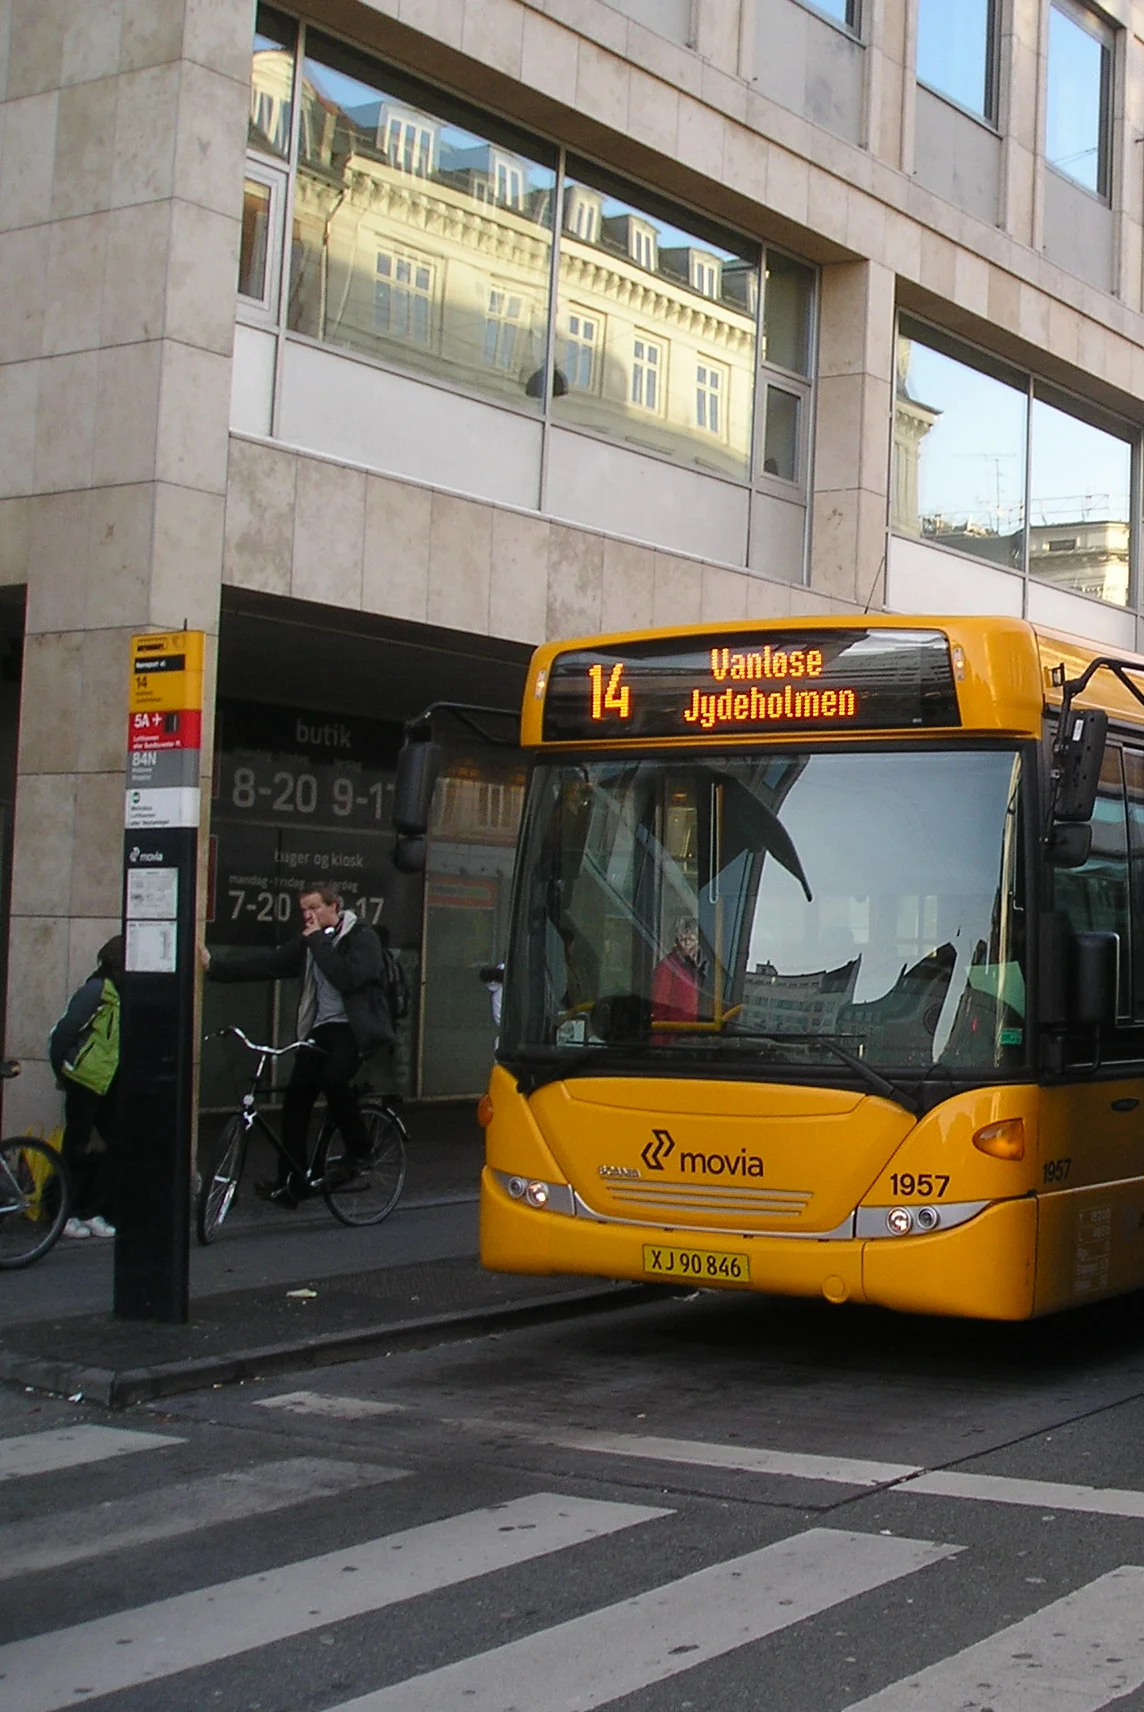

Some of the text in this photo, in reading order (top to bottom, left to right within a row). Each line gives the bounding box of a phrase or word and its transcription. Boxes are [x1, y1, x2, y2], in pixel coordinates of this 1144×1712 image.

[711, 645, 823, 681] Vanløse
[137, 676, 148, 688] 14
[588, 662, 630, 720] 14
[134, 713, 150, 728] 5A
[683, 685, 856, 728] Jydeholmen
[296, 718, 352, 748] butik
[231, 766, 396, 820] 8-20 9-1
[313, 854, 330, 869] og
[332, 853, 364, 868] kiosk
[228, 890, 291, 923] 7-20
[680, 1147, 765, 1178] movia
[1043, 1157, 1072, 1184] 1957
[890, 1173, 950, 1198] 1957
[651, 1249, 742, 1278] XJ 90 846
